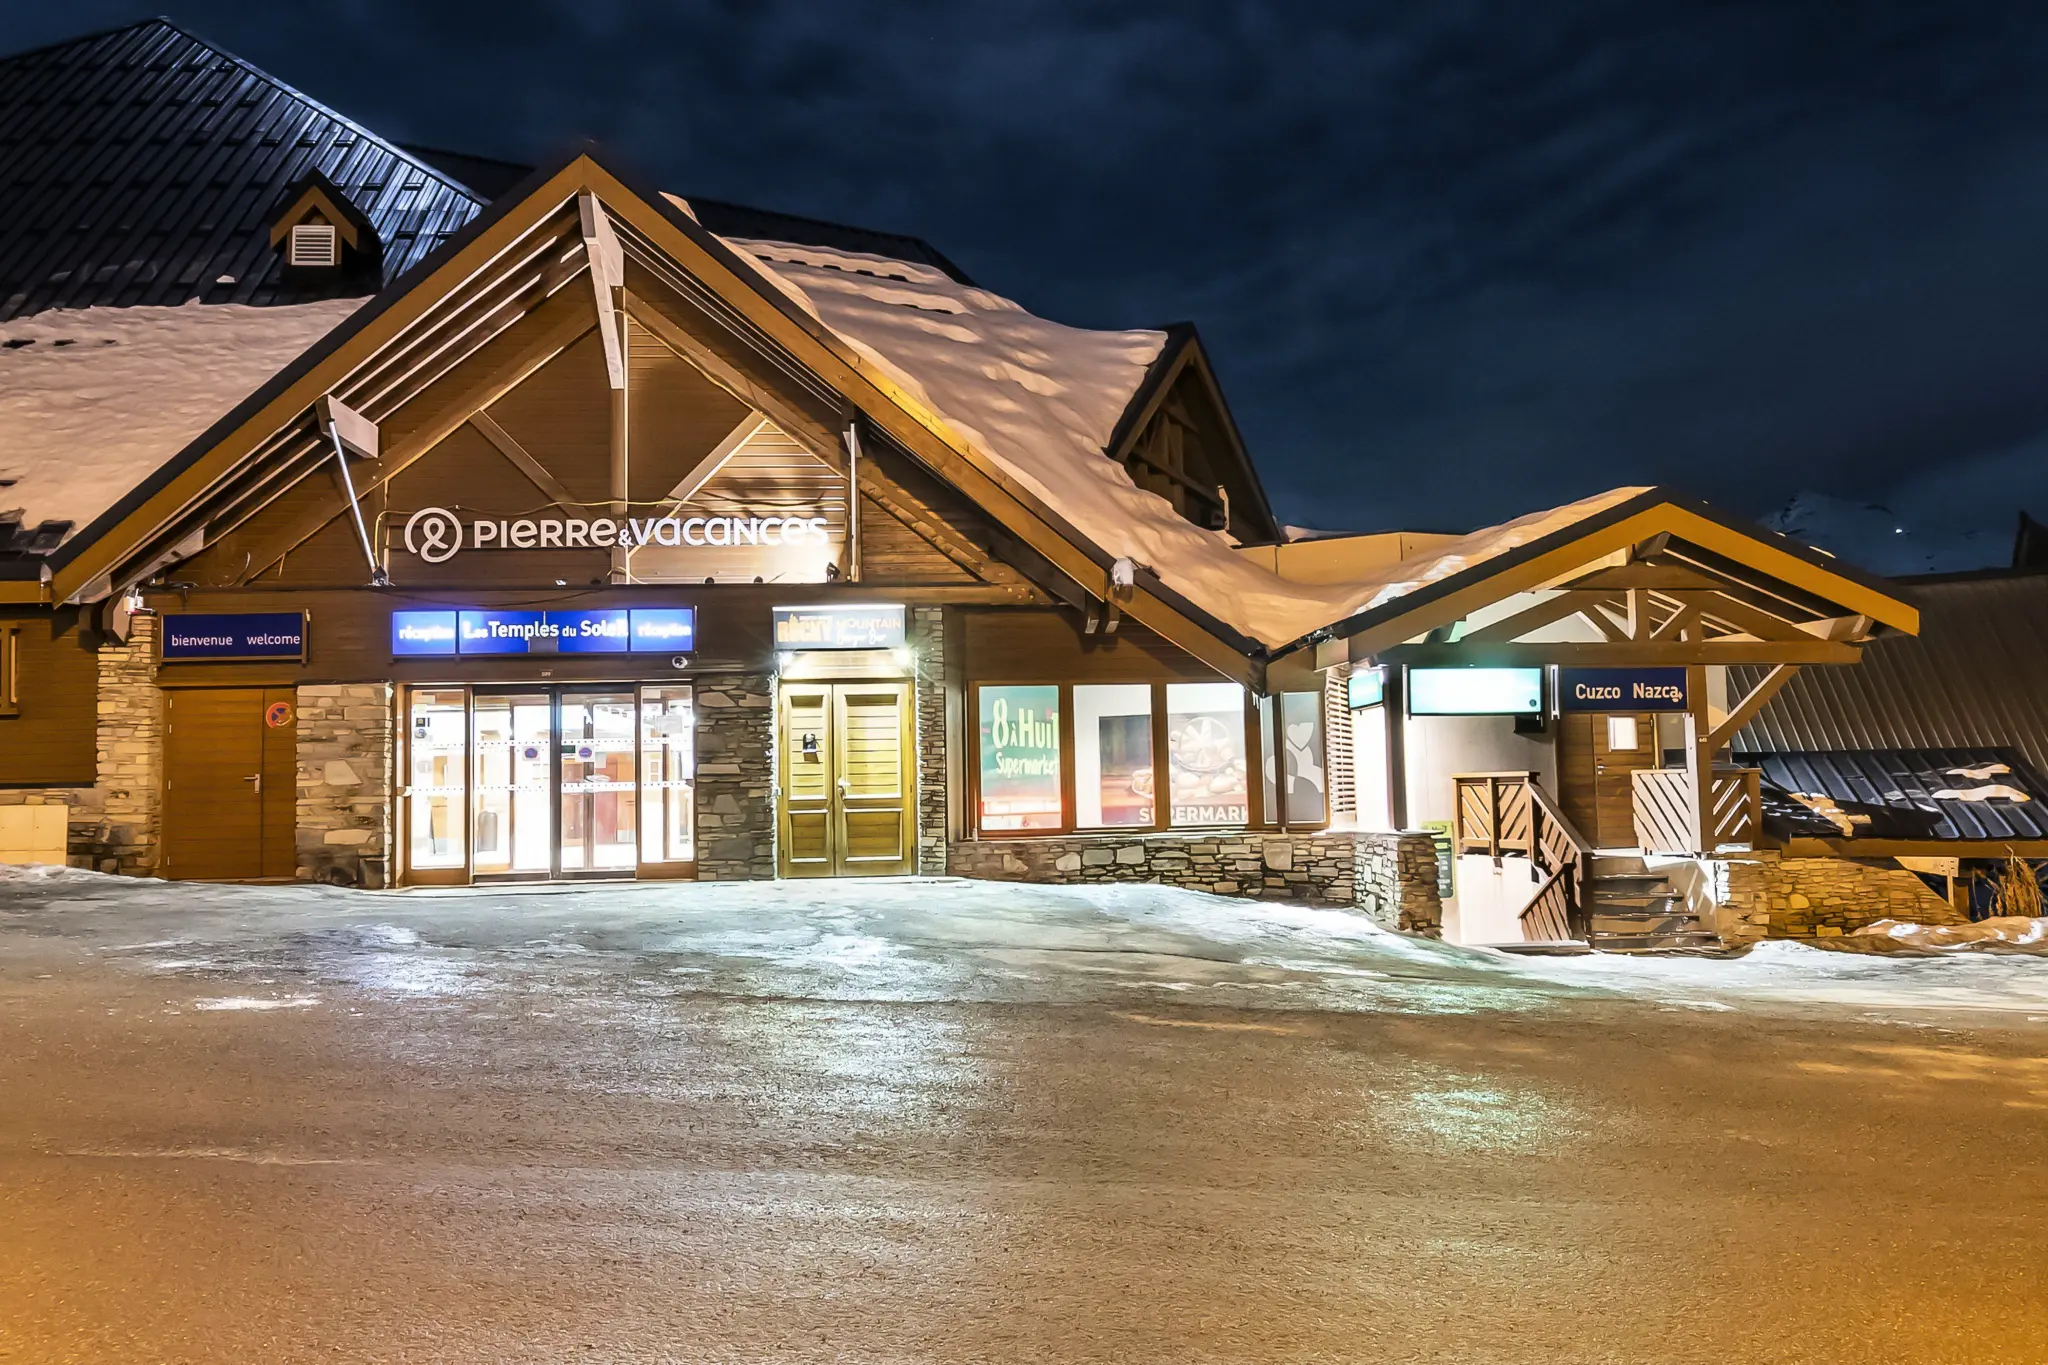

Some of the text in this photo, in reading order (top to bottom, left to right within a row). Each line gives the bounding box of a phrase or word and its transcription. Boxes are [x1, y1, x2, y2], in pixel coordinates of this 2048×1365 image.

[171, 633, 300, 647] bienvenue welcome
[488, 620, 560, 641] Temples
[562, 625, 577, 637] du
[1575, 682, 1679, 700] Cuzco Nazca
[992, 697, 1010, 749] 8
